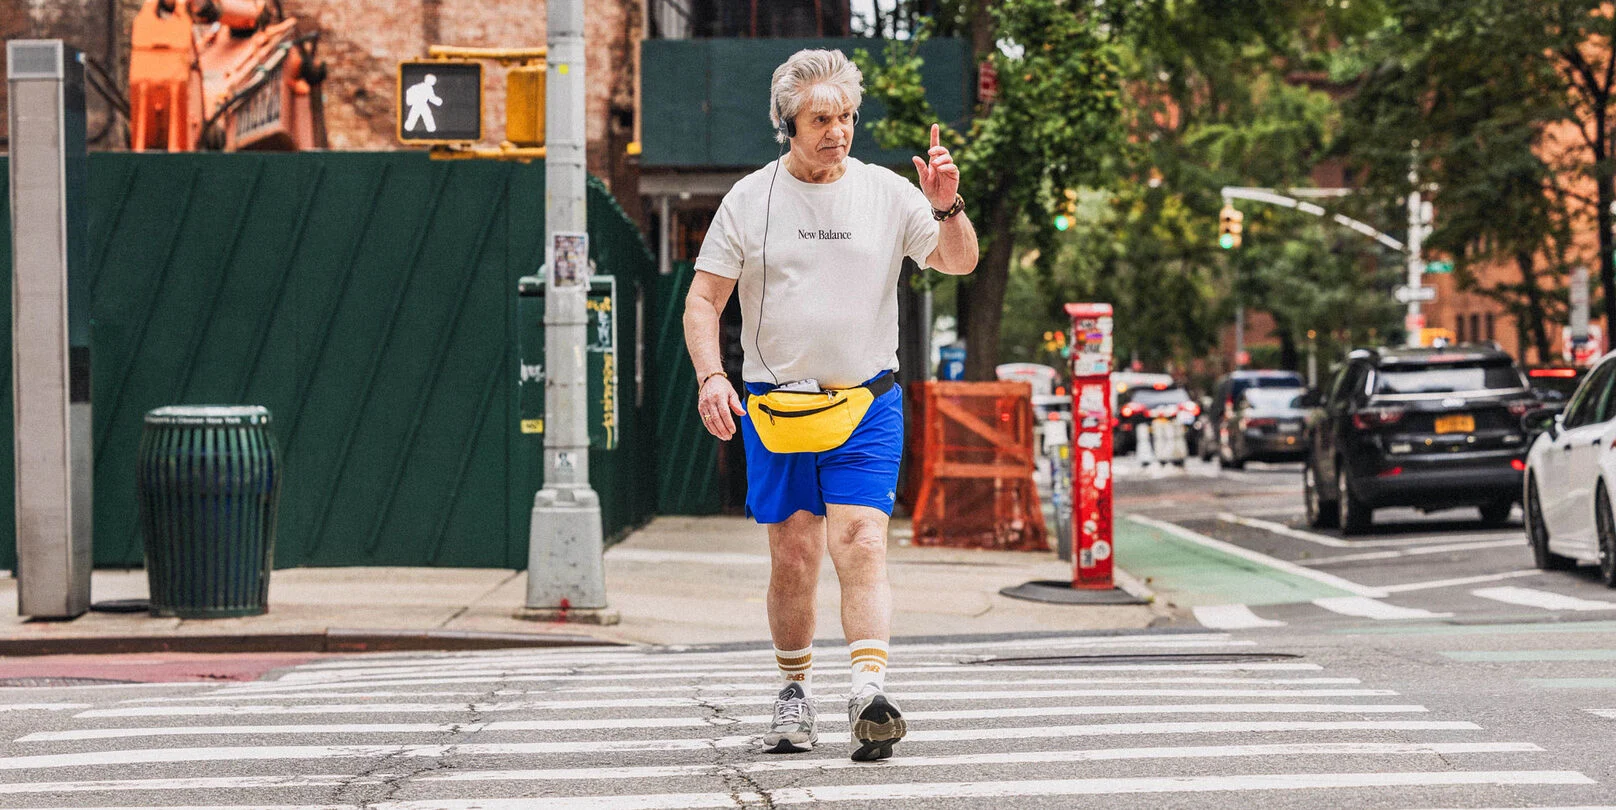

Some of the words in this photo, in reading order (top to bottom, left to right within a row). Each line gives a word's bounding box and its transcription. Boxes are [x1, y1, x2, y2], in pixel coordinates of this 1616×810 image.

[798, 229, 816, 240] New
[818, 229, 852, 240] Balance
[950, 361, 964, 380] P
